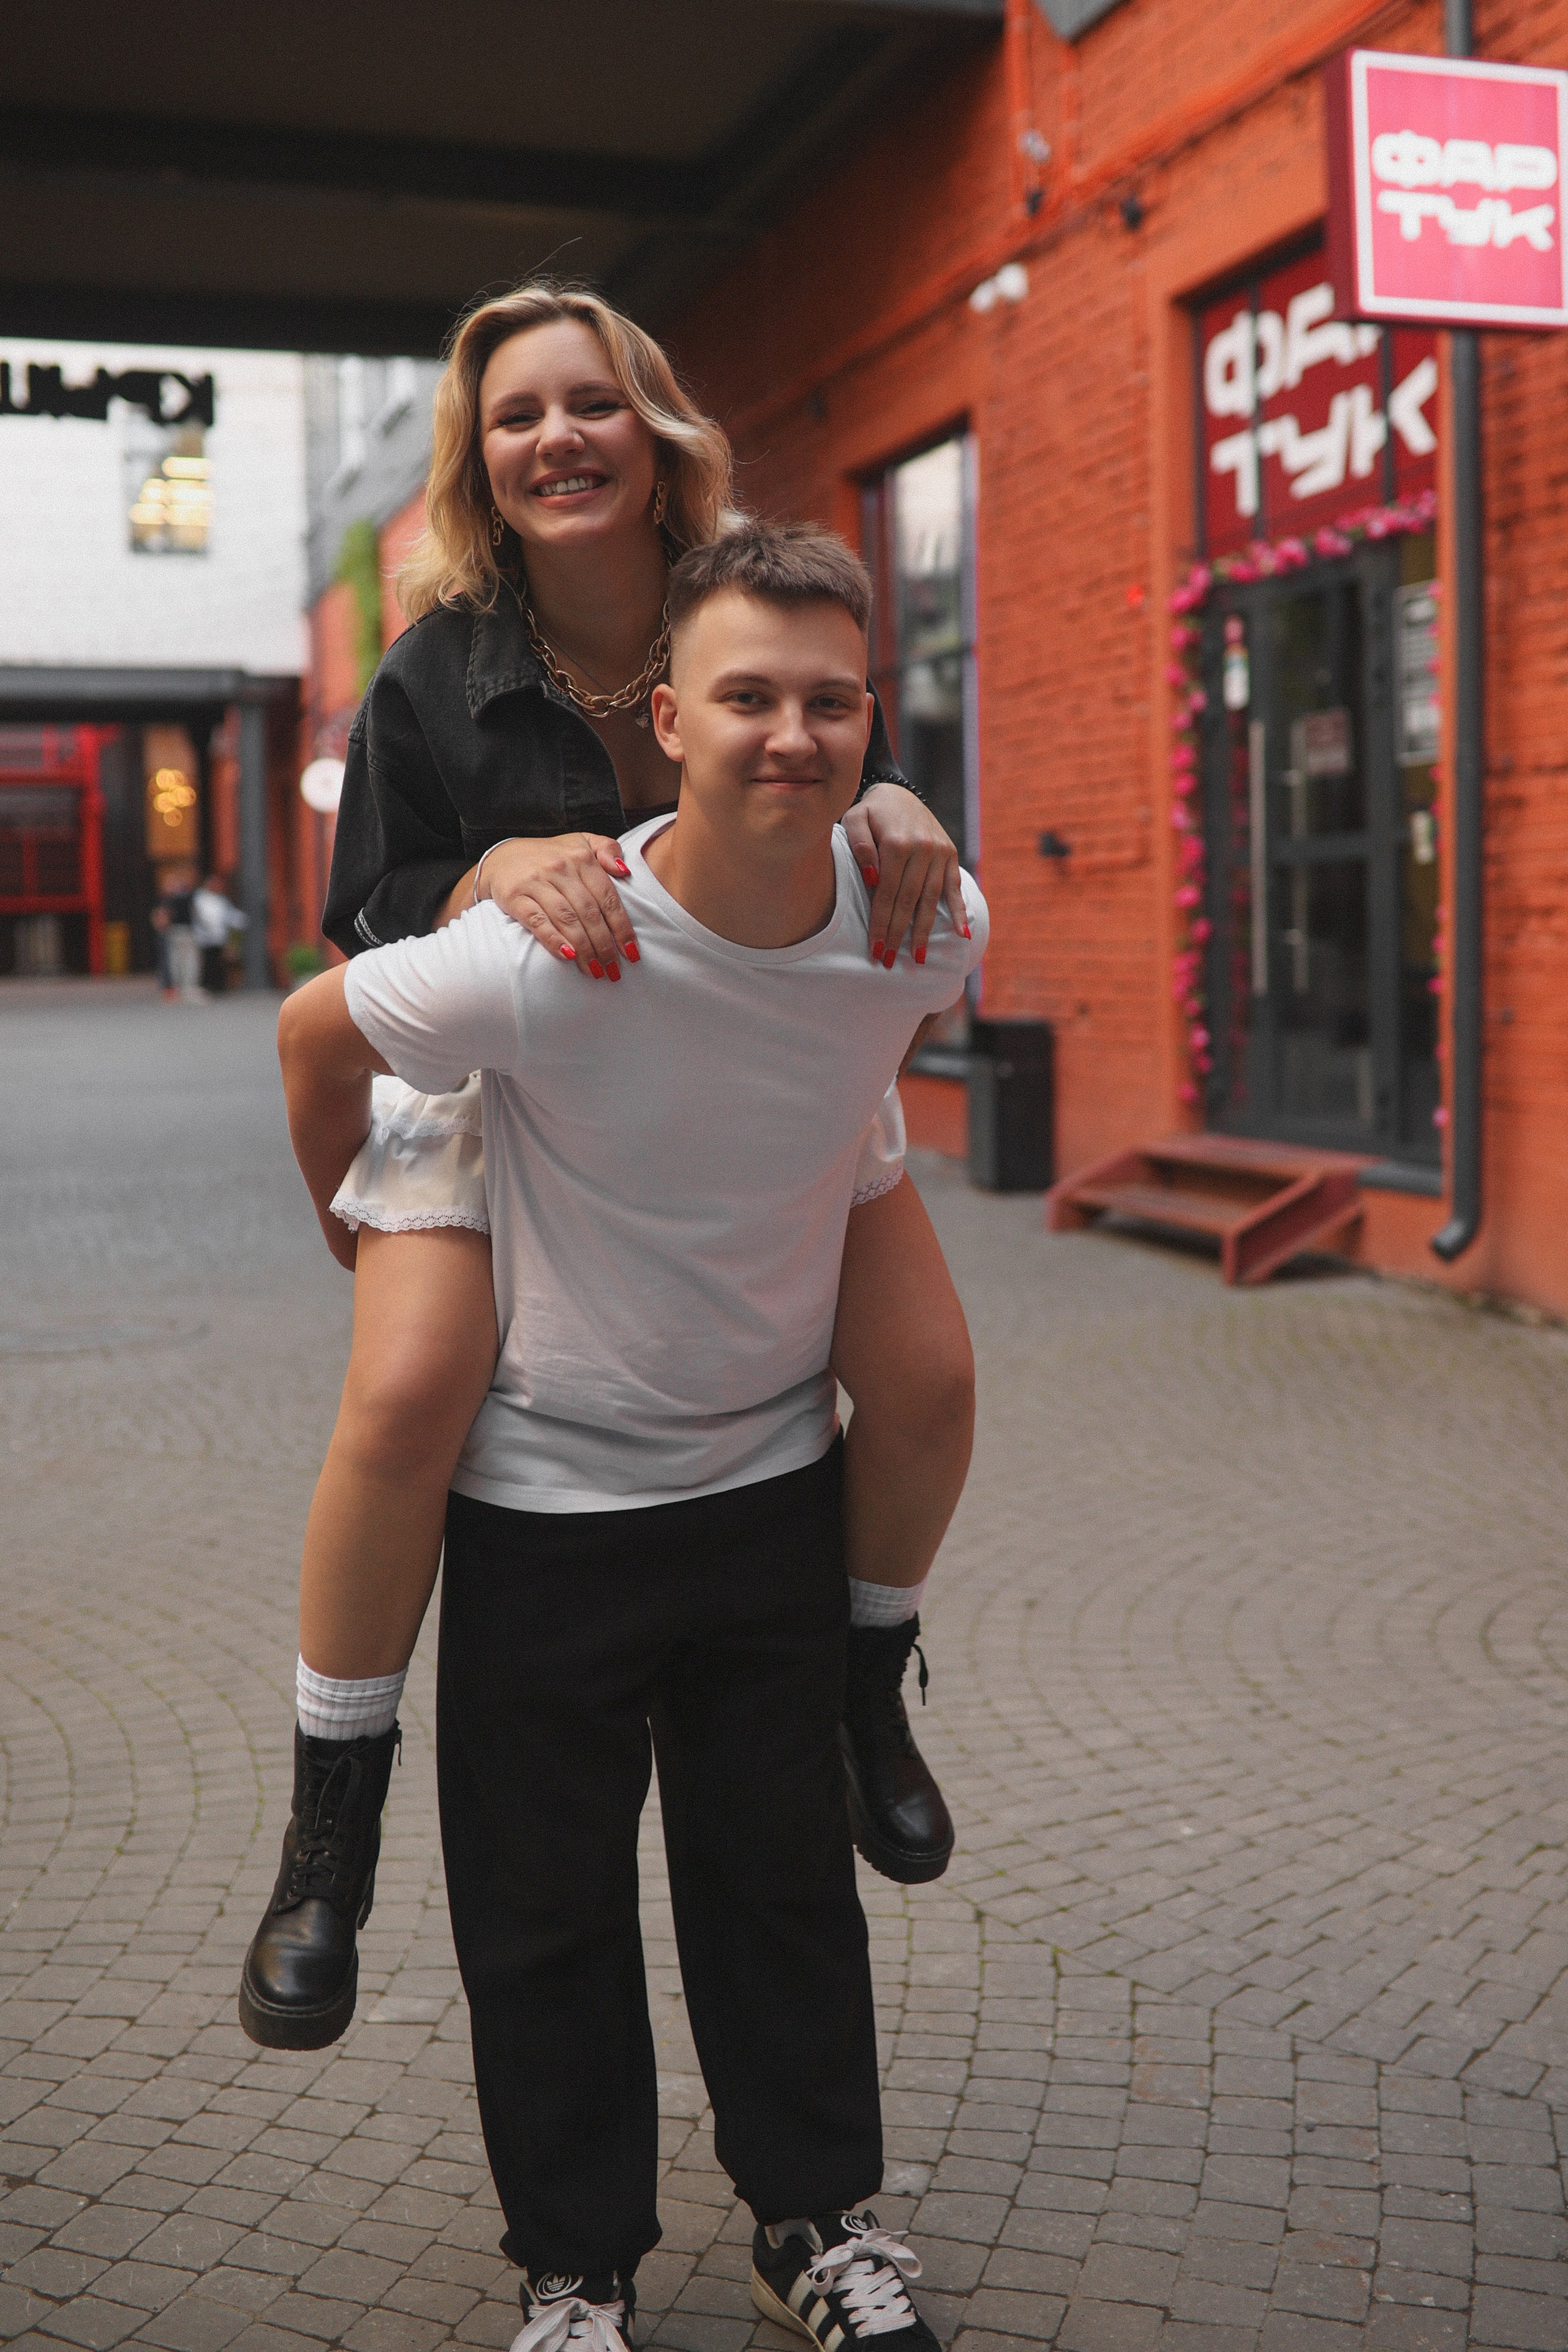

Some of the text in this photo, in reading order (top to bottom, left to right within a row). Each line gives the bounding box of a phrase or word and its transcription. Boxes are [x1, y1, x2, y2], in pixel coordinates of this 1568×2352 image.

[1373, 130, 1557, 190] ФАР
[1378, 190, 1555, 250] ТУК
[1205, 283, 1383, 418] ФА
[1211, 356, 1437, 516] ТУК
